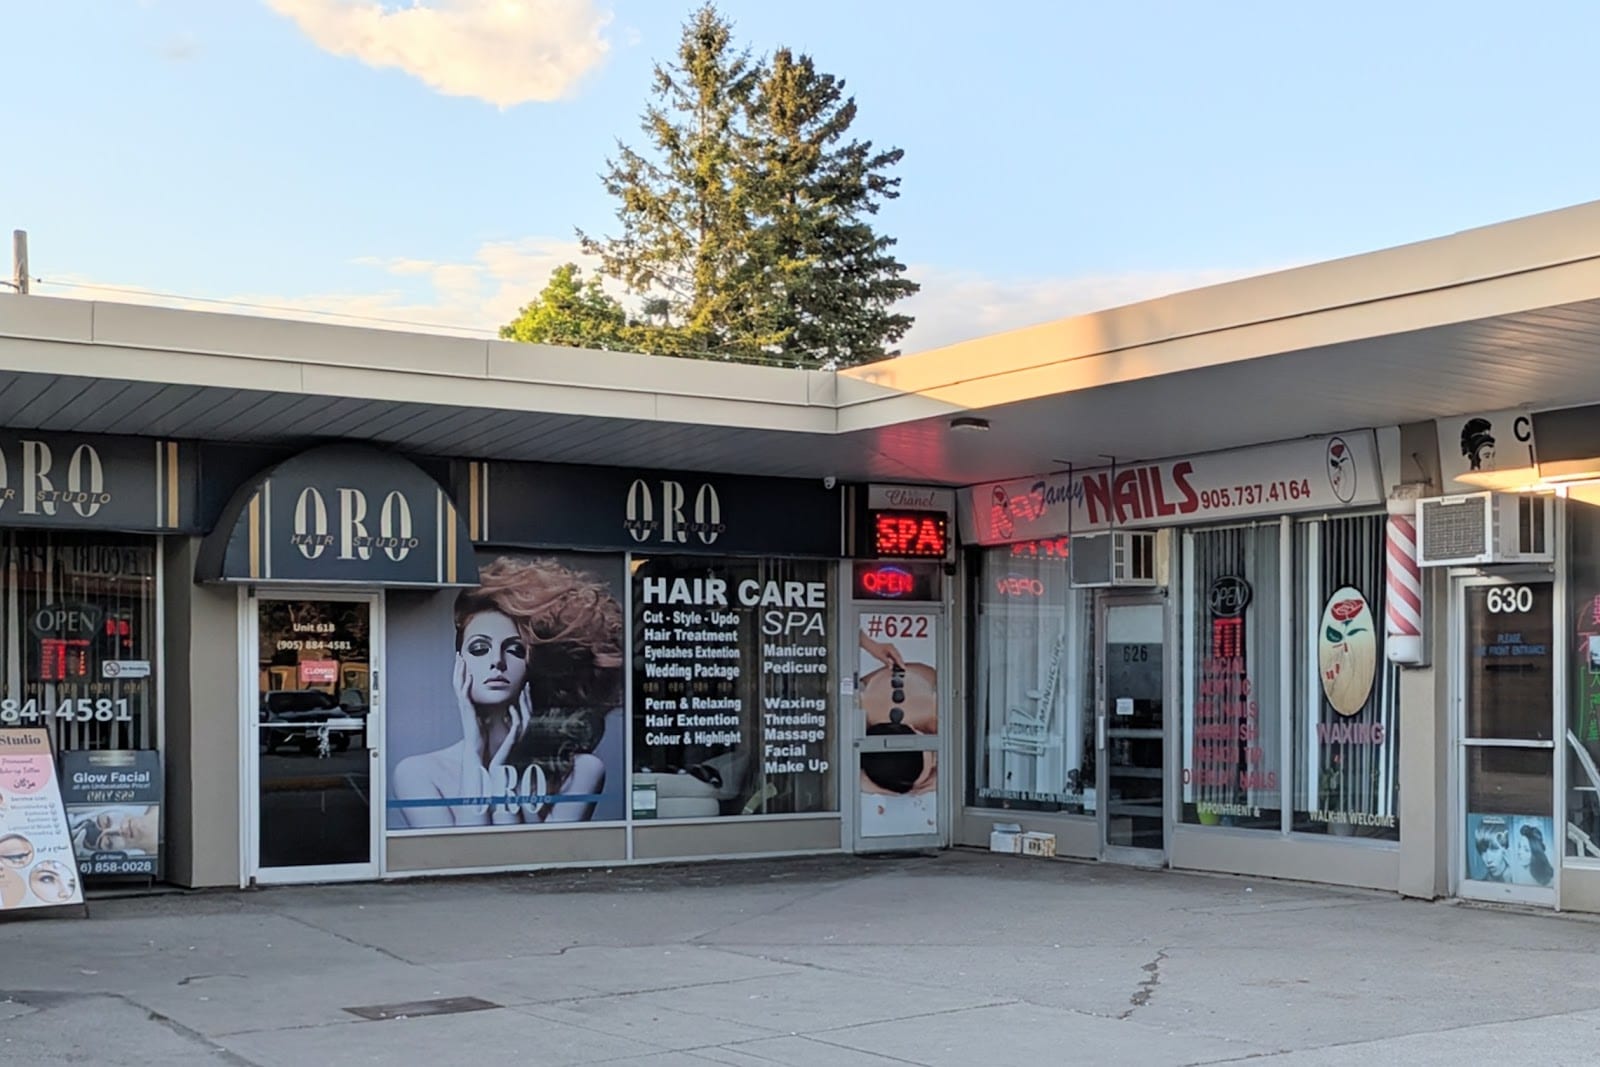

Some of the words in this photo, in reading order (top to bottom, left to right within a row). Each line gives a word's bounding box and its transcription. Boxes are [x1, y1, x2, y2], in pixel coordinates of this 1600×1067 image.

[0, 440, 104, 518] RO
[37, 491, 112, 504] STUDIO
[885, 489, 935, 507] Chanel
[1083, 461, 1199, 524] NAILS
[1200, 478, 1311, 509] 905.737.4164
[625, 478, 721, 545] ORO
[294, 486, 412, 562] ORO
[623, 520, 659, 531] HAIR
[674, 521, 727, 534] STUDIO
[290, 534, 335, 546] HAIR
[353, 536, 420, 549] STUDIO
[878, 518, 942, 550] SPA
[863, 572, 914, 592] OPEN
[643, 577, 728, 605] HAIR
[738, 580, 826, 608] CARE
[1211, 586, 1244, 610] OPEN
[1487, 586, 1533, 613] 630
[36, 609, 96, 632] OPEN
[643, 611, 663, 624] Cut
[673, 611, 702, 626] Style
[711, 612, 740, 627] Updo
[762, 611, 826, 636] SPA
[868, 615, 928, 638] #622
[293, 623, 315, 633] Unit
[644, 628, 670, 641] Hair
[674, 629, 738, 642] Treatment
[277, 640, 304, 651] (905)
[305, 640, 351, 651] 884-4581
[644, 645, 693, 660] Eyelashes
[695, 646, 741, 659] Extention
[764, 644, 827, 657] Manicure
[645, 664, 692, 680] Wedding
[694, 664, 740, 680] Package
[764, 662, 827, 674] Pedicure
[645, 698, 676, 710] Perm
[680, 698, 689, 709] &
[692, 697, 741, 711] Relaxing
[764, 697, 825, 711] Waxing
[645, 714, 674, 727] Hair
[677, 714, 739, 726] Extention
[764, 714, 825, 727] Threading
[645, 732, 681, 745] Colour
[684, 732, 691, 744] &
[694, 730, 741, 747] Highlight
[764, 729, 825, 742] Massage
[1316, 721, 1385, 745] WAXING
[765, 744, 807, 757] Facial
[765, 760, 804, 774] Make
[808, 759, 829, 772] Up
[73, 772, 108, 783] Glow
[110, 770, 150, 783] Facial
[1197, 801, 1252, 817] APPOINTMENT
[1253, 806, 1261, 818] &
[1309, 809, 1348, 823] WALK-IN
[1349, 811, 1395, 827] WELCOME
[95, 861, 152, 872] 858-0028
